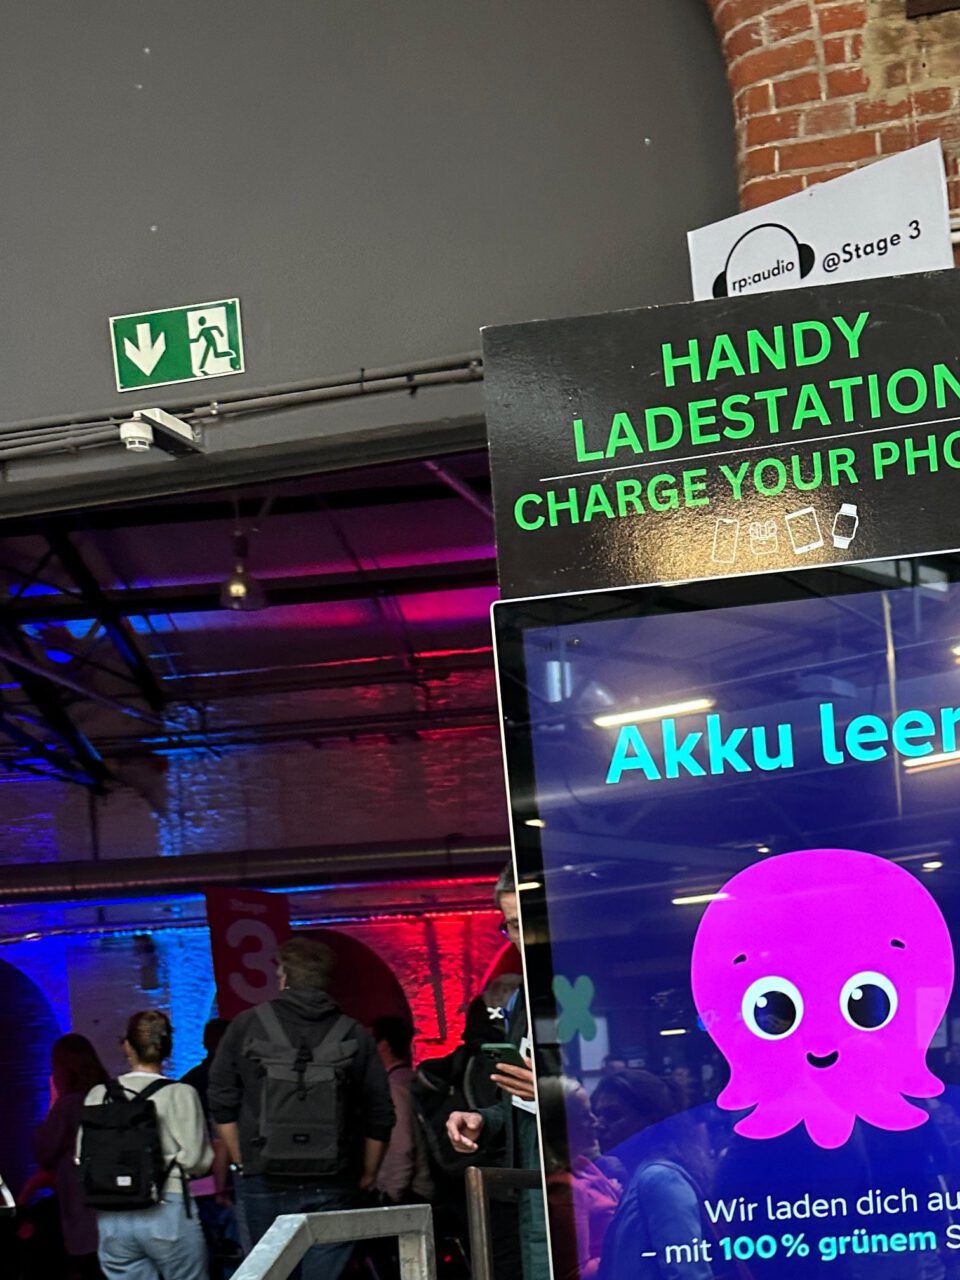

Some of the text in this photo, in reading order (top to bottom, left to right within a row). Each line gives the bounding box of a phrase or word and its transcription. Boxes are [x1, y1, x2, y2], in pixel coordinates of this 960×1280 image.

[732, 260, 795, 292] rp:audio
[822, 219, 921, 273] @Stage 3
[661, 311, 870, 388] HANDY
[513, 468, 710, 532] CHARGE
[720, 447, 859, 501] YOUR
[605, 713, 795, 784] Akku
[226, 918, 283, 1006] 3
[704, 1197, 759, 1223] Wir
[766, 1193, 847, 1220] laden
[856, 1187, 918, 1216] dich
[665, 1238, 713, 1264] mit
[818, 1228, 937, 1261] grünem
